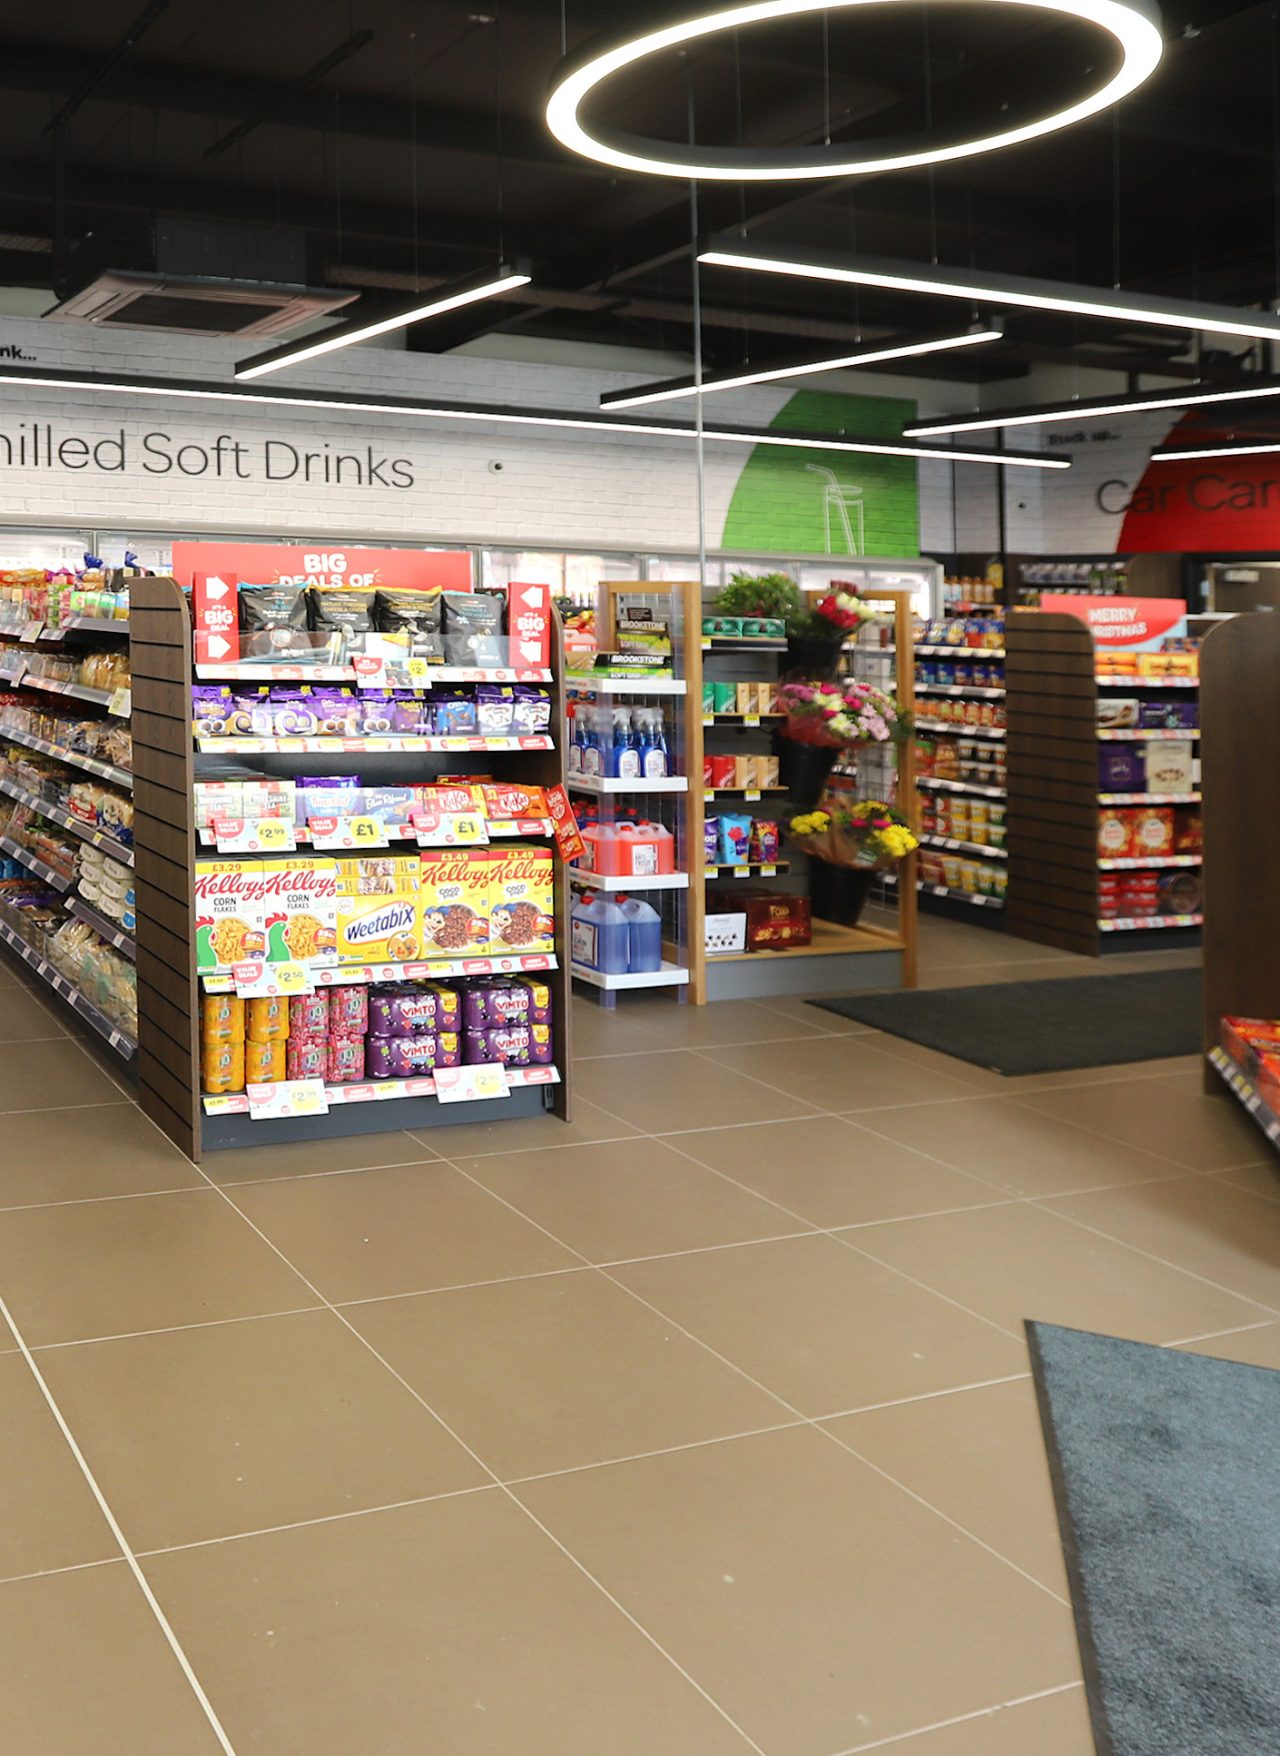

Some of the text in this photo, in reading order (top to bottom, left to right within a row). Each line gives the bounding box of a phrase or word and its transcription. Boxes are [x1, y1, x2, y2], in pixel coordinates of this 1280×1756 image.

[141, 432, 251, 479] Soft
[264, 440, 416, 489] Drinks
[1096, 479, 1178, 515] Car
[303, 553, 348, 574] BIG
[279, 573, 376, 588] DEALS OF
[204, 610, 234, 625] BIG
[1087, 607, 1137, 622] MERRY
[517, 617, 545, 631] BIG
[611, 655, 664, 665] BROOKSTONE
[356, 823, 374, 836] £1
[458, 821, 475, 833] £1
[441, 852, 469, 861] £3.49
[507, 851, 534, 860] £3.49
[212, 863, 242, 872] £3.29
[286, 861, 314, 870] £3.29
[213, 897, 237, 906] CORN
[287, 894, 310, 903] CORN
[346, 904, 416, 941] Weetabix
